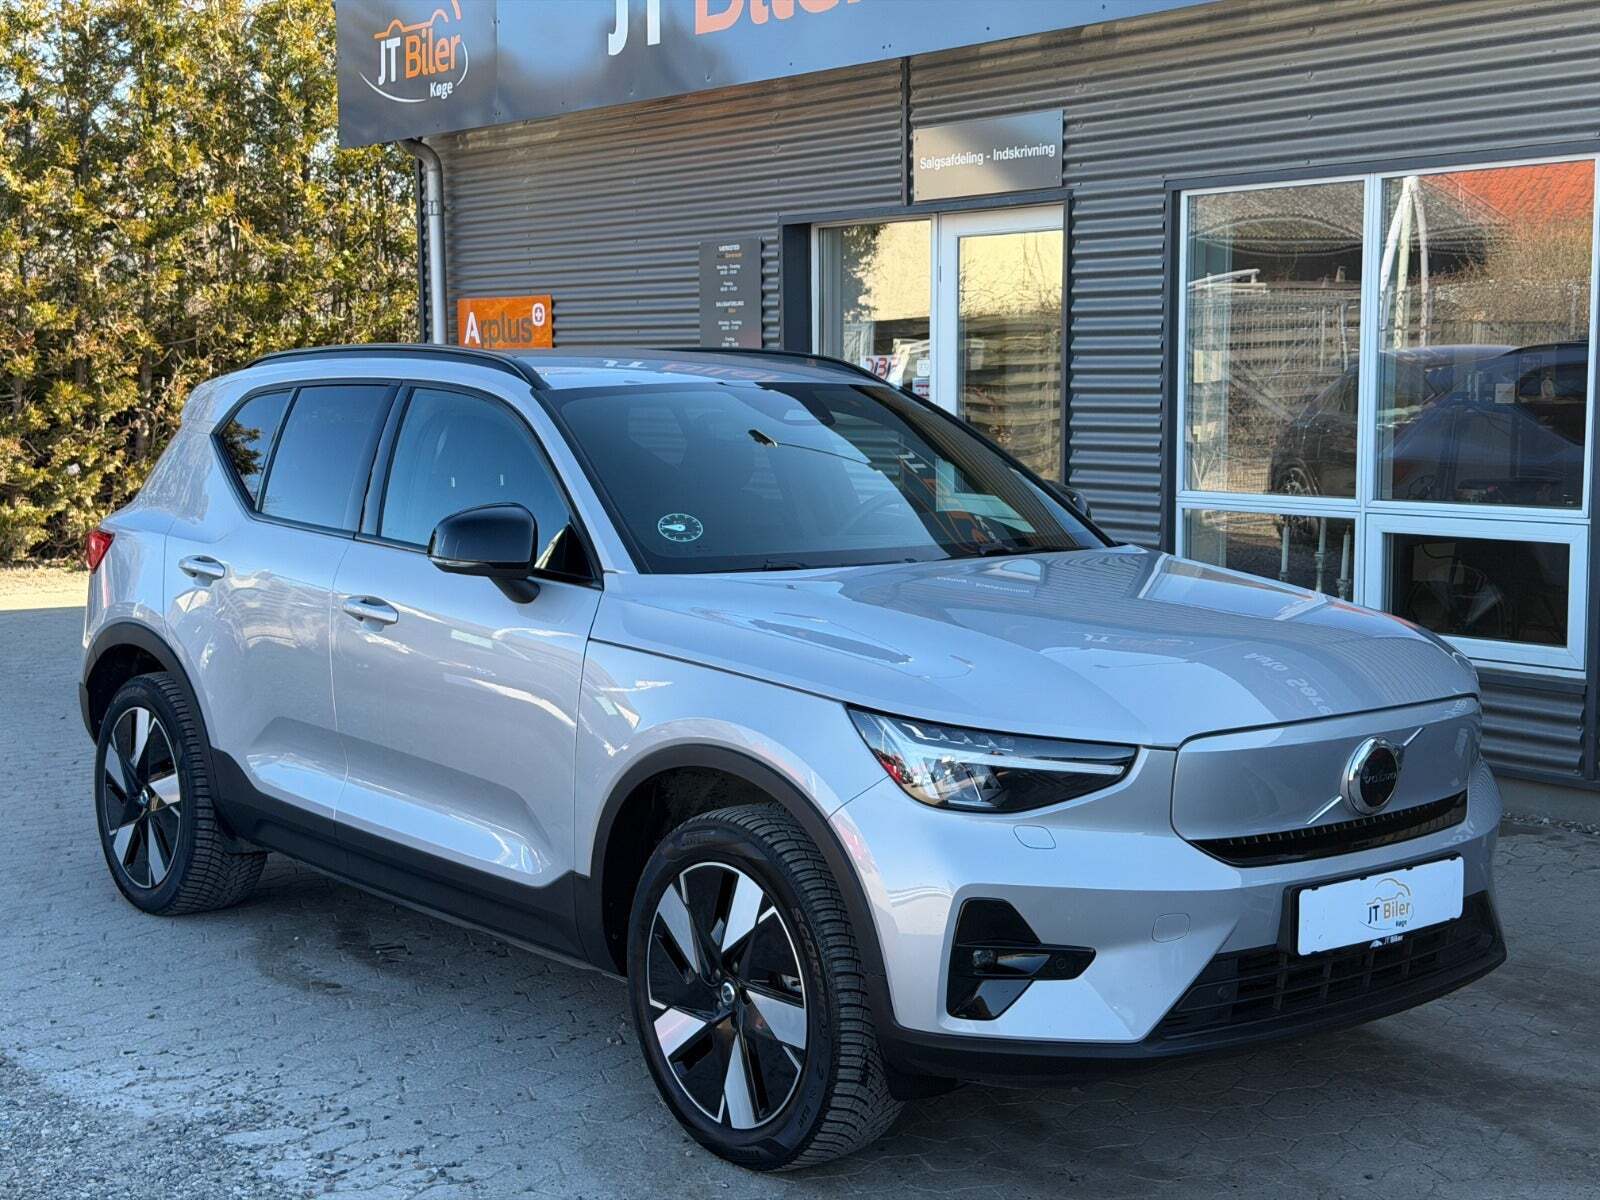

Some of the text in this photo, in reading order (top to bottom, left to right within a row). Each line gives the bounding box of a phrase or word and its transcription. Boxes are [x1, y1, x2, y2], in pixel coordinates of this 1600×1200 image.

[377, 27, 461, 86] JT Biler
[430, 81, 453, 99] Køge
[920, 151, 984, 171] Salgsafdeling
[993, 142, 1056, 161] Indskrivning
[1368, 900, 1410, 925] JT Biler
